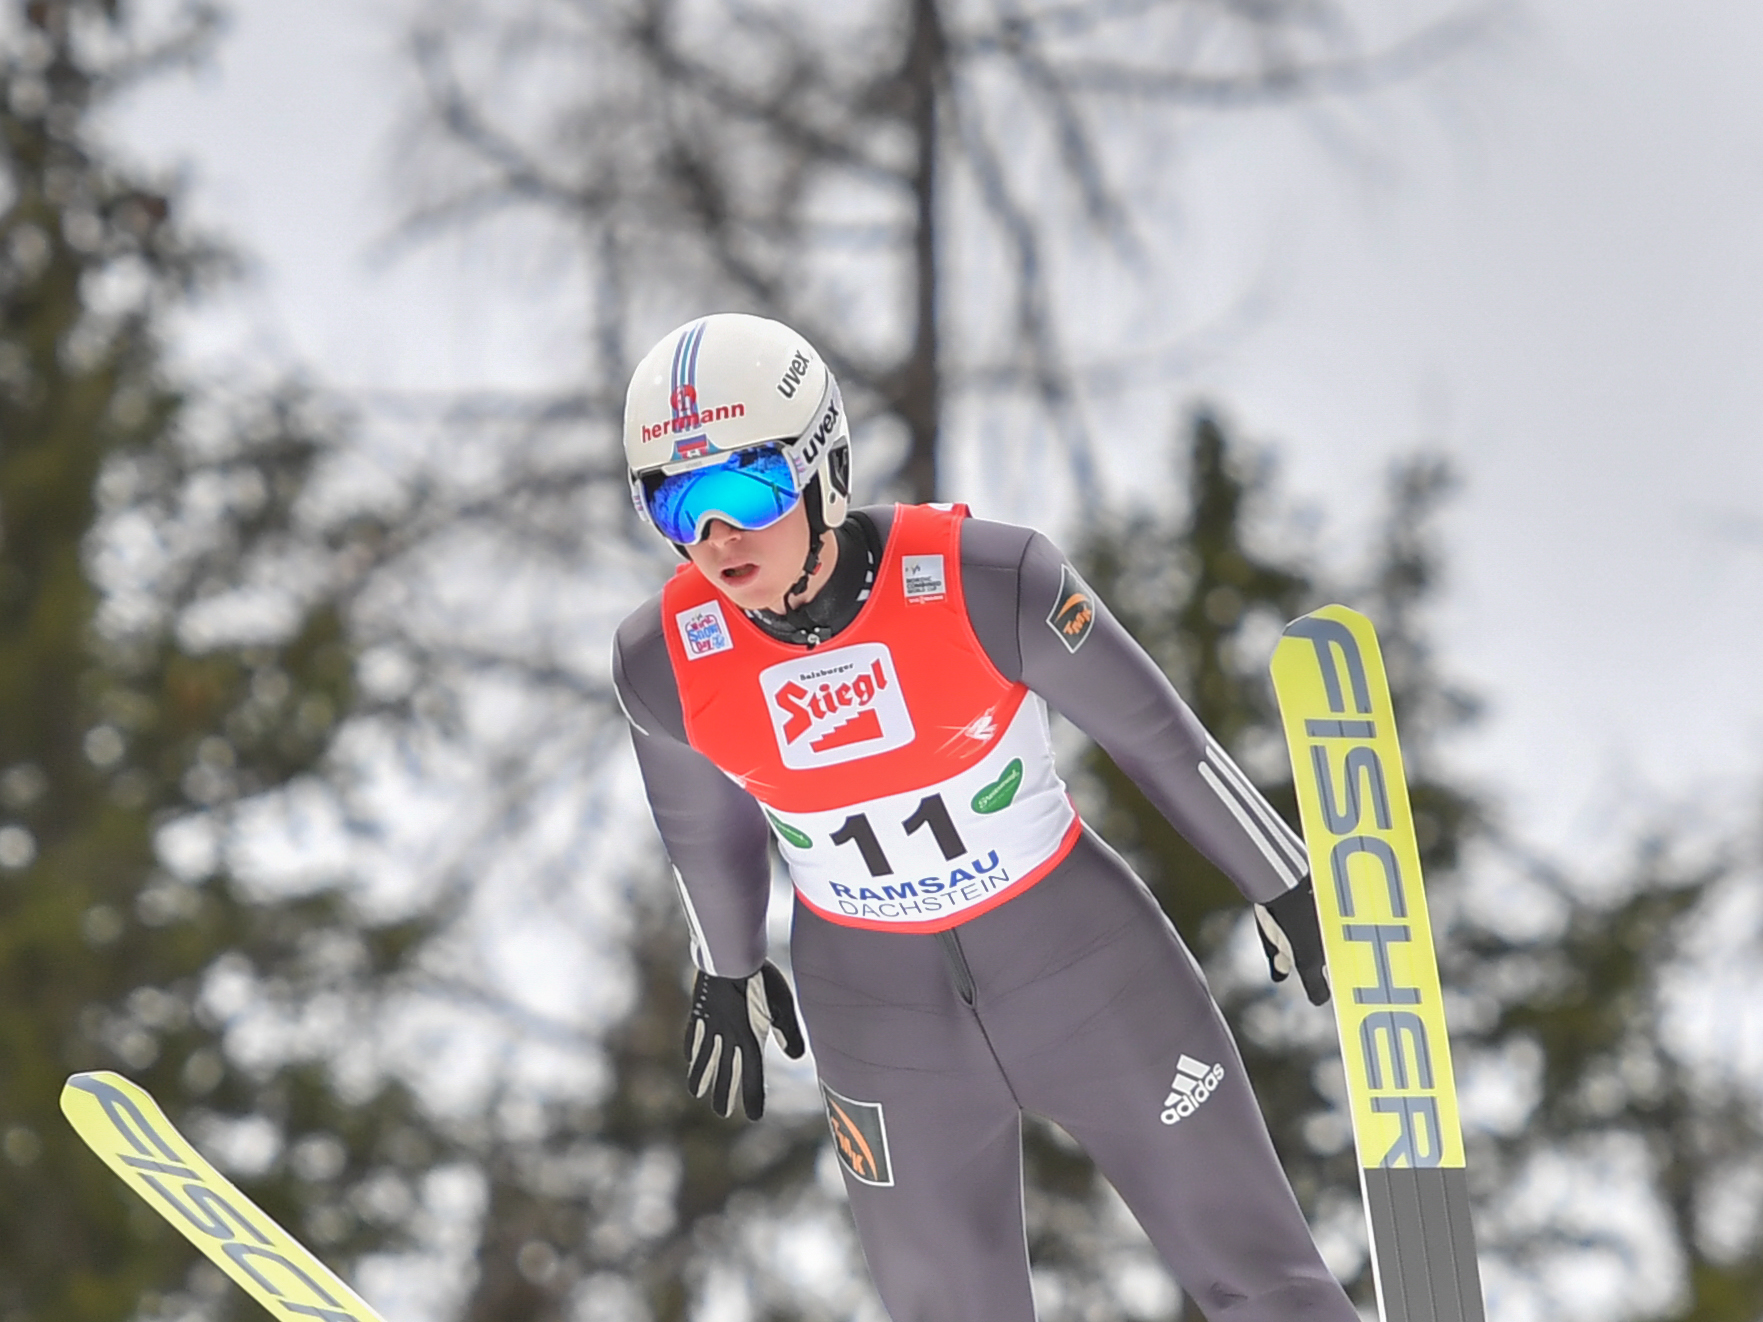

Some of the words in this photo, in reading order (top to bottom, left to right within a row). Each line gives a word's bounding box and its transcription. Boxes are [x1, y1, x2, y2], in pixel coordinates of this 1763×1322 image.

[776, 349, 810, 399] uvex
[801, 399, 840, 465] uvex
[775, 658, 888, 746] Stiegl
[829, 793, 967, 877] 11
[829, 850, 1000, 901] RAMSAU
[839, 868, 1010, 918] DACHSTEIN
[1284, 617, 1443, 1168] FISCHER
[1160, 1063, 1225, 1125] adidas
